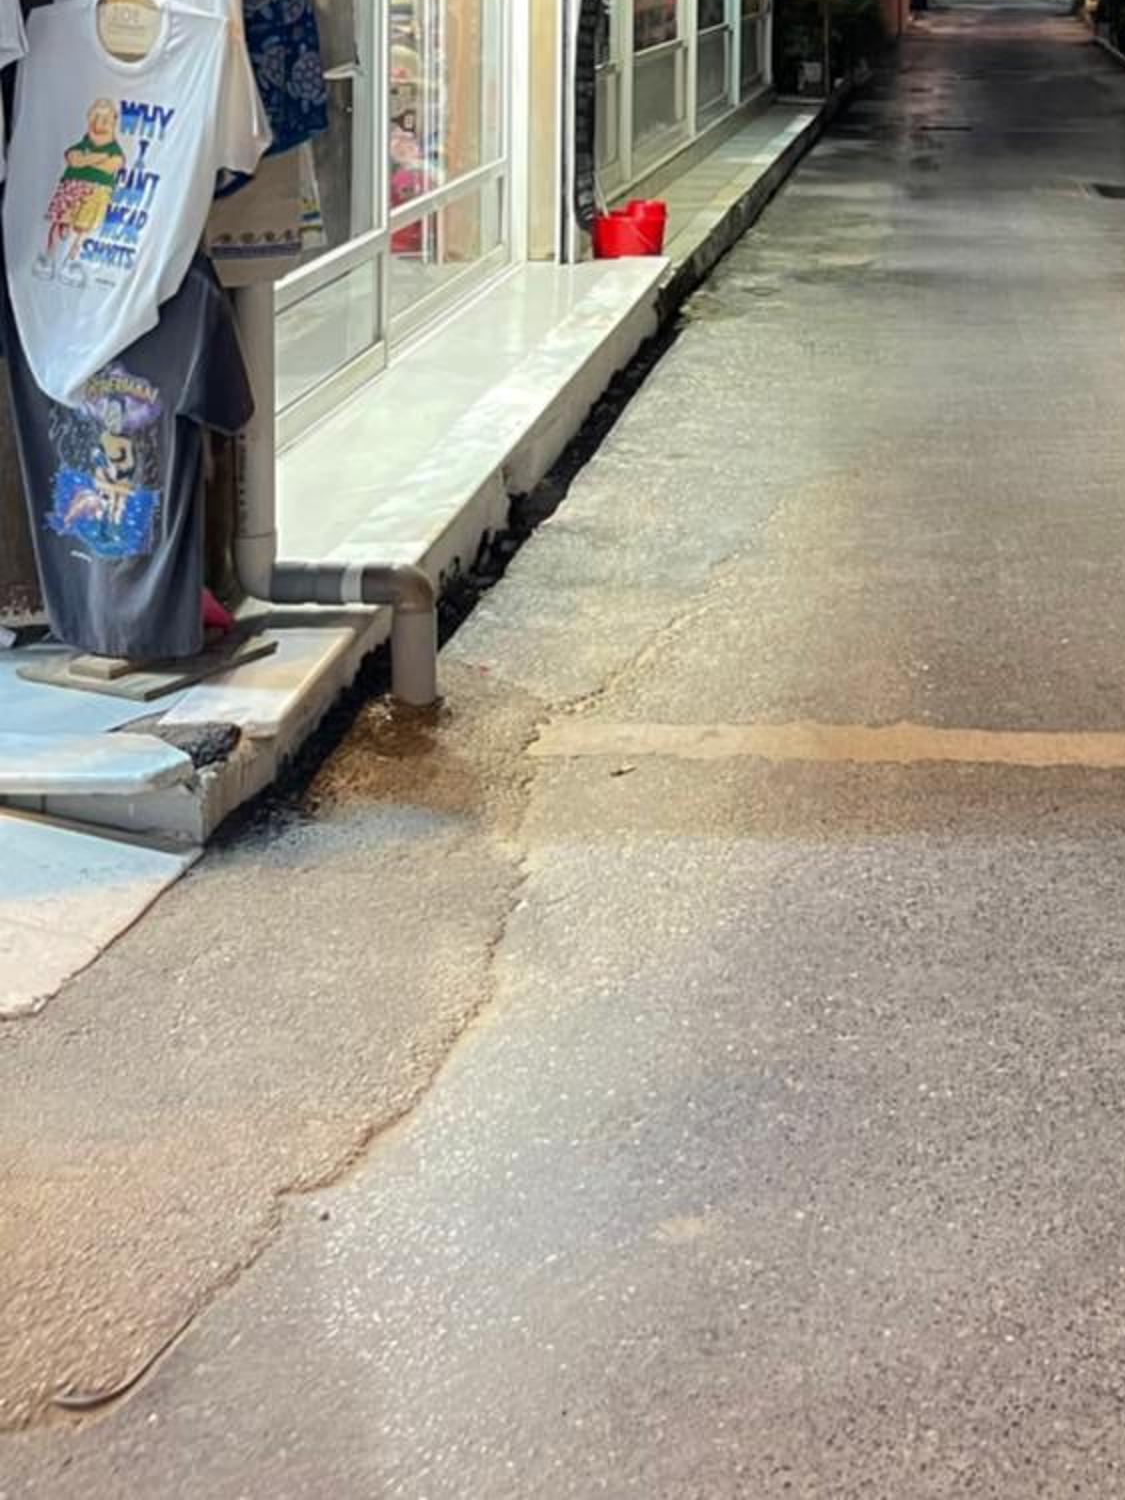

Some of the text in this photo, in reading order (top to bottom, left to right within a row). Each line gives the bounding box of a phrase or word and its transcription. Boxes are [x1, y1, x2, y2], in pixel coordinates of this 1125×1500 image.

[121, 100, 174, 140] WHY
[100, 203, 149, 243] WEAR
[80, 238, 136, 269] SHORTS
